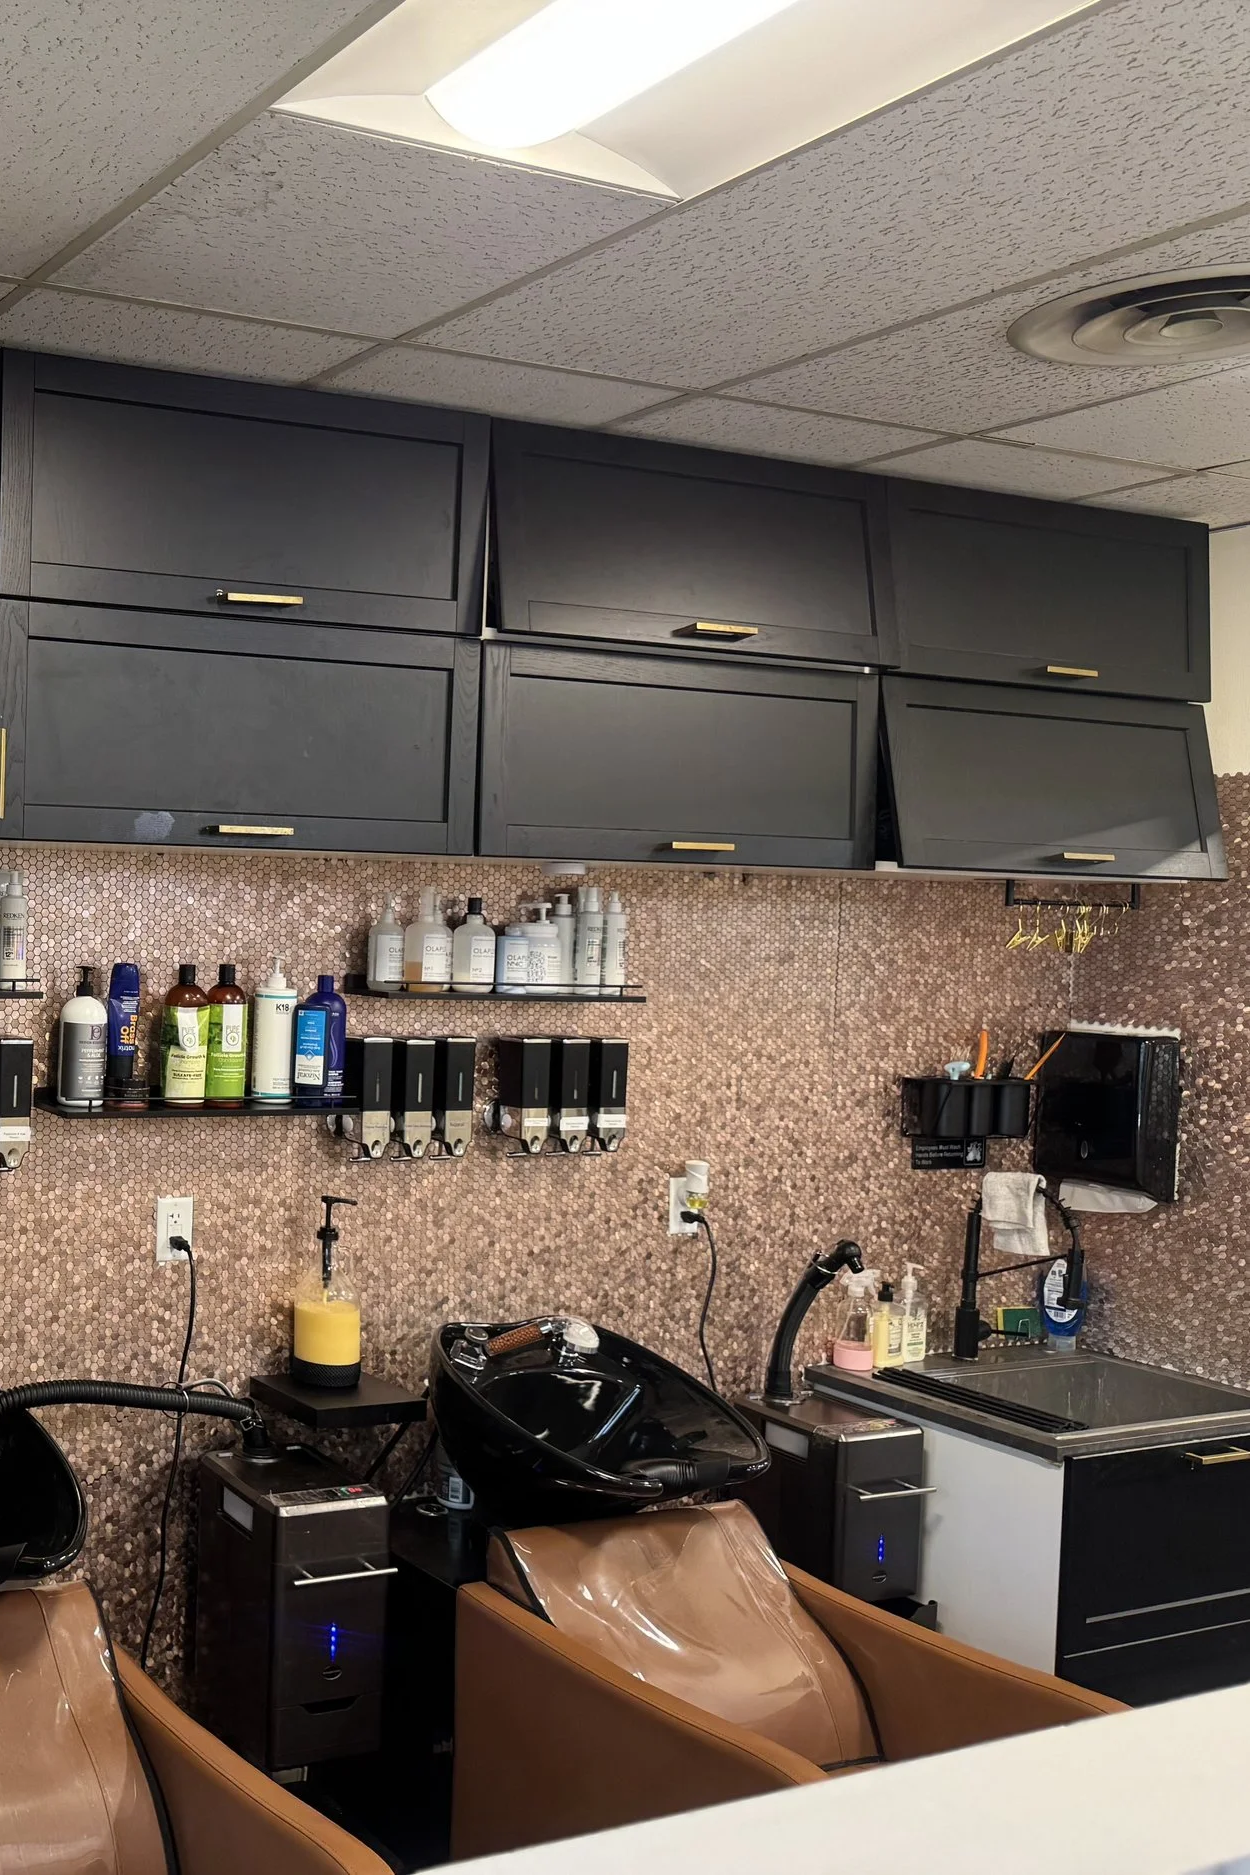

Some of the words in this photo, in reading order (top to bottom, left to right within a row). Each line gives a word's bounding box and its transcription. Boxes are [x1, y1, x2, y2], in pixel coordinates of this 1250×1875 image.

[275, 1003, 290, 1012] K18
[119, 1025, 130, 1045] Off
[130, 1014, 139, 1045] Brass
[296, 1071, 321, 1081] Nizoral
